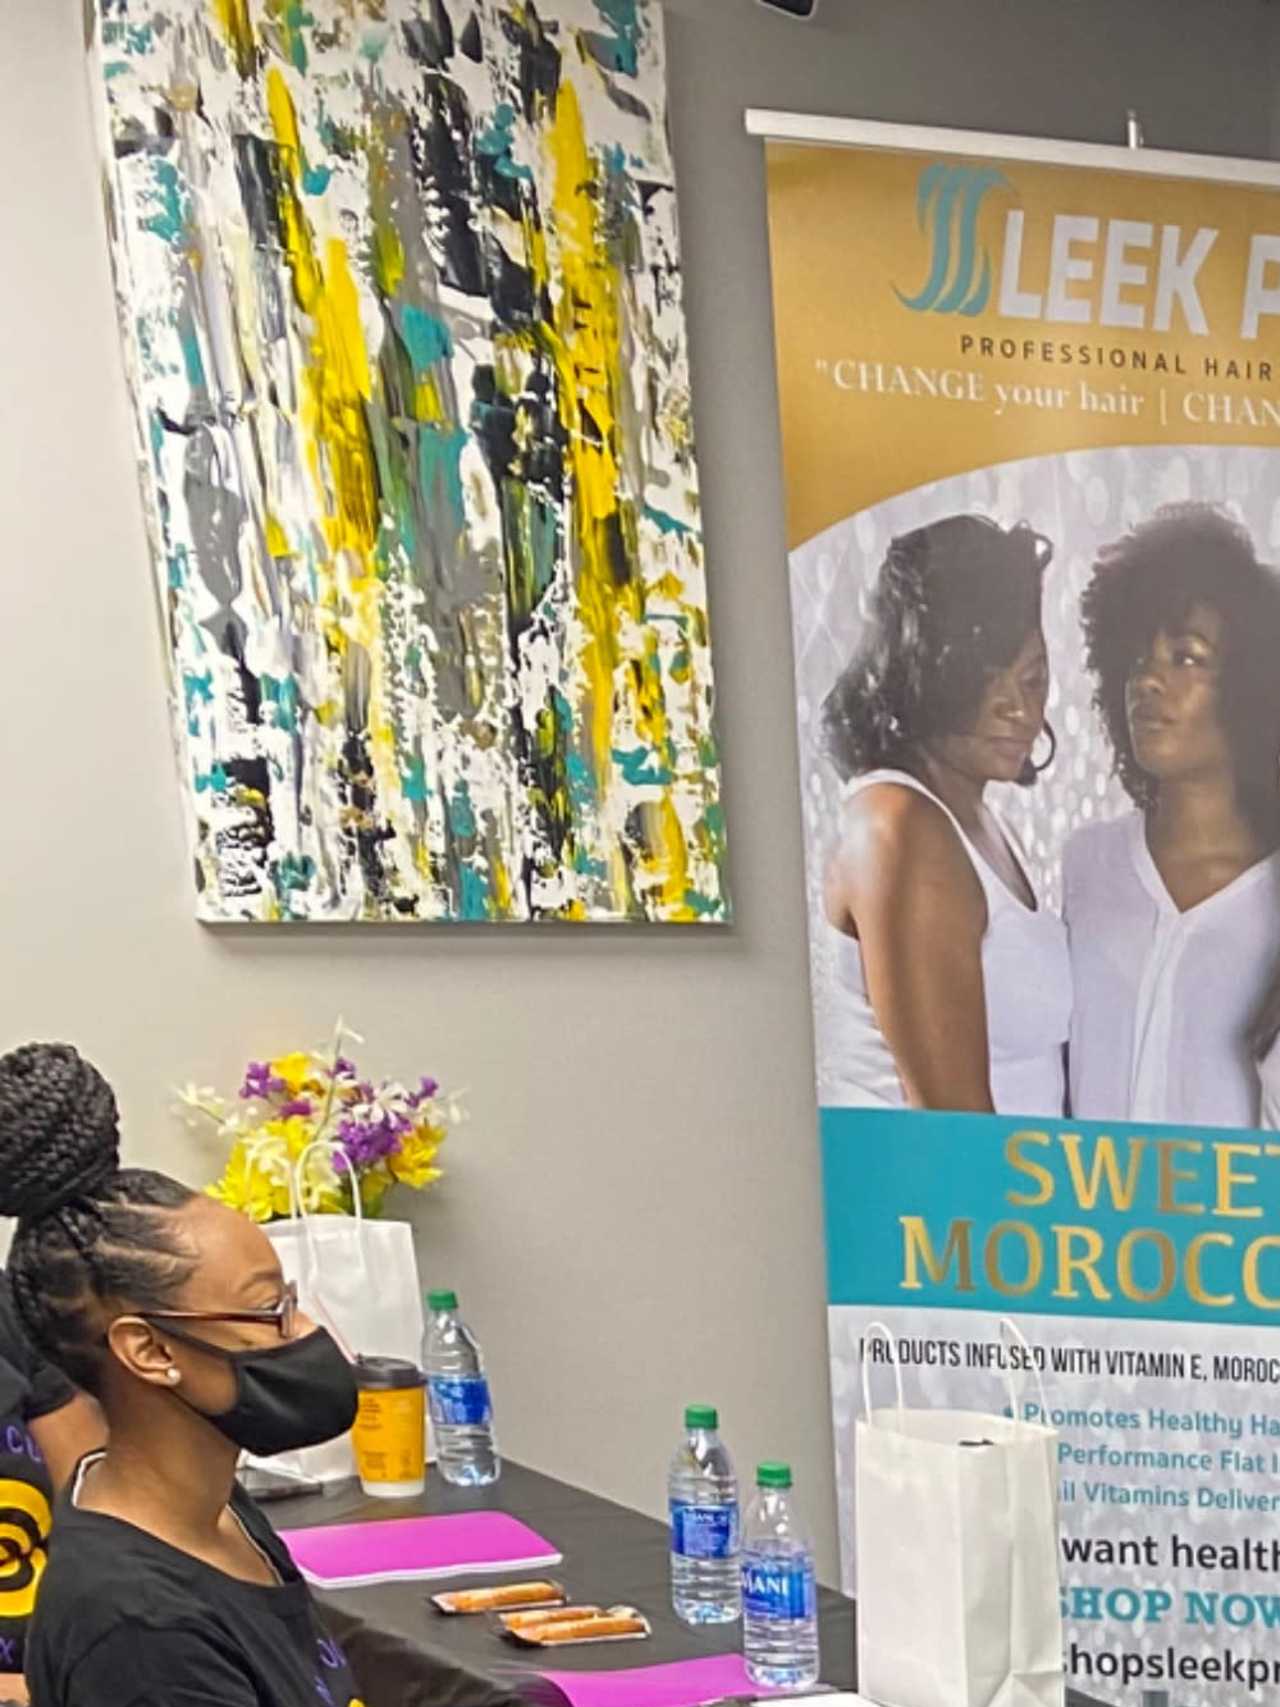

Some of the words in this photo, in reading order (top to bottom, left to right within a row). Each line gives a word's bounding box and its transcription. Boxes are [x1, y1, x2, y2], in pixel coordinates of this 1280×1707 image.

[960, 334, 1186, 375] PROFESSIONAL
[1205, 357, 1272, 382] HAIR
[994, 383, 1071, 416] your
[1080, 381, 1145, 416] hair
[1050, 1347, 1100, 1375] WITH
[1104, 1350, 1185, 1379] VITAMIN
[1149, 1408, 1242, 1439] Healthy
[1057, 1442, 1213, 1471] Performance
[1220, 1450, 1265, 1473] Flat
[1083, 1481, 1190, 1507] Vitamins
[1062, 1535, 1159, 1567] want
